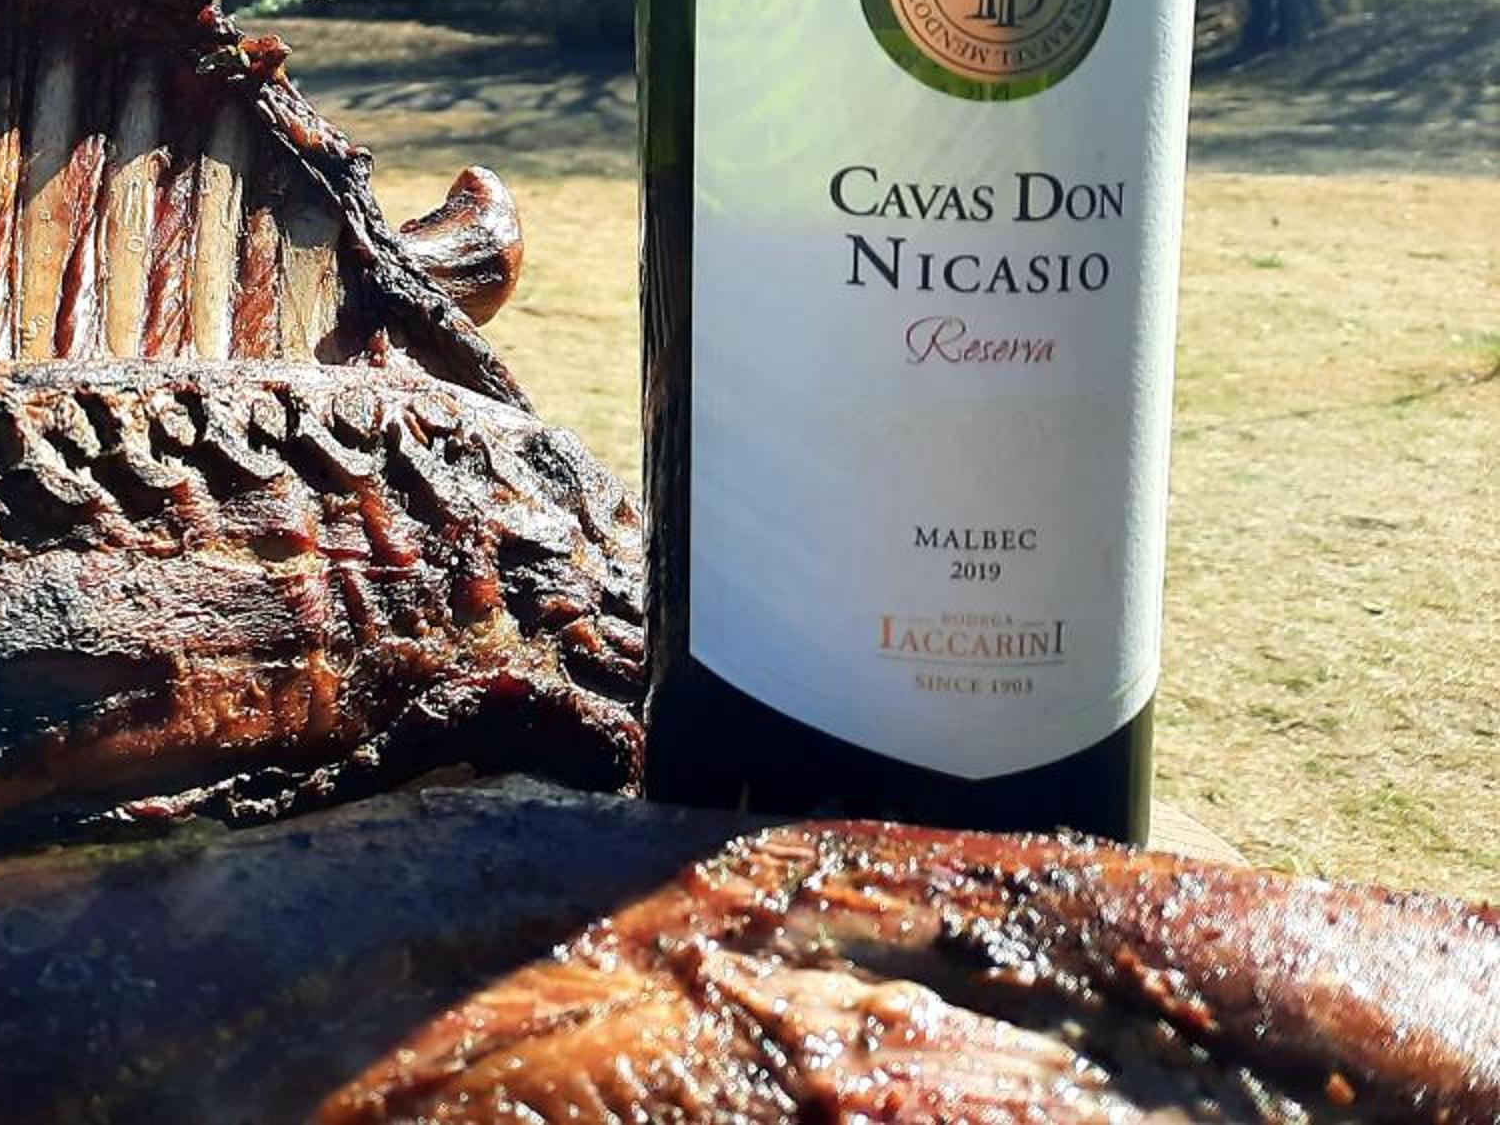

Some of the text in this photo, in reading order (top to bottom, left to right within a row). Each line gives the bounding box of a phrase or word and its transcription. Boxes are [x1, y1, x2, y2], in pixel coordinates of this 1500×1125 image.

[829, 165, 1125, 222] CAVAS DON
[845, 233, 1110, 294] NICASIO
[905, 314, 1057, 364] Reserva
[914, 526, 1038, 551] MALBEC
[950, 561, 1001, 581] 2019
[879, 615, 1066, 658] IACCARINI
[915, 674, 983, 694] SINCE
